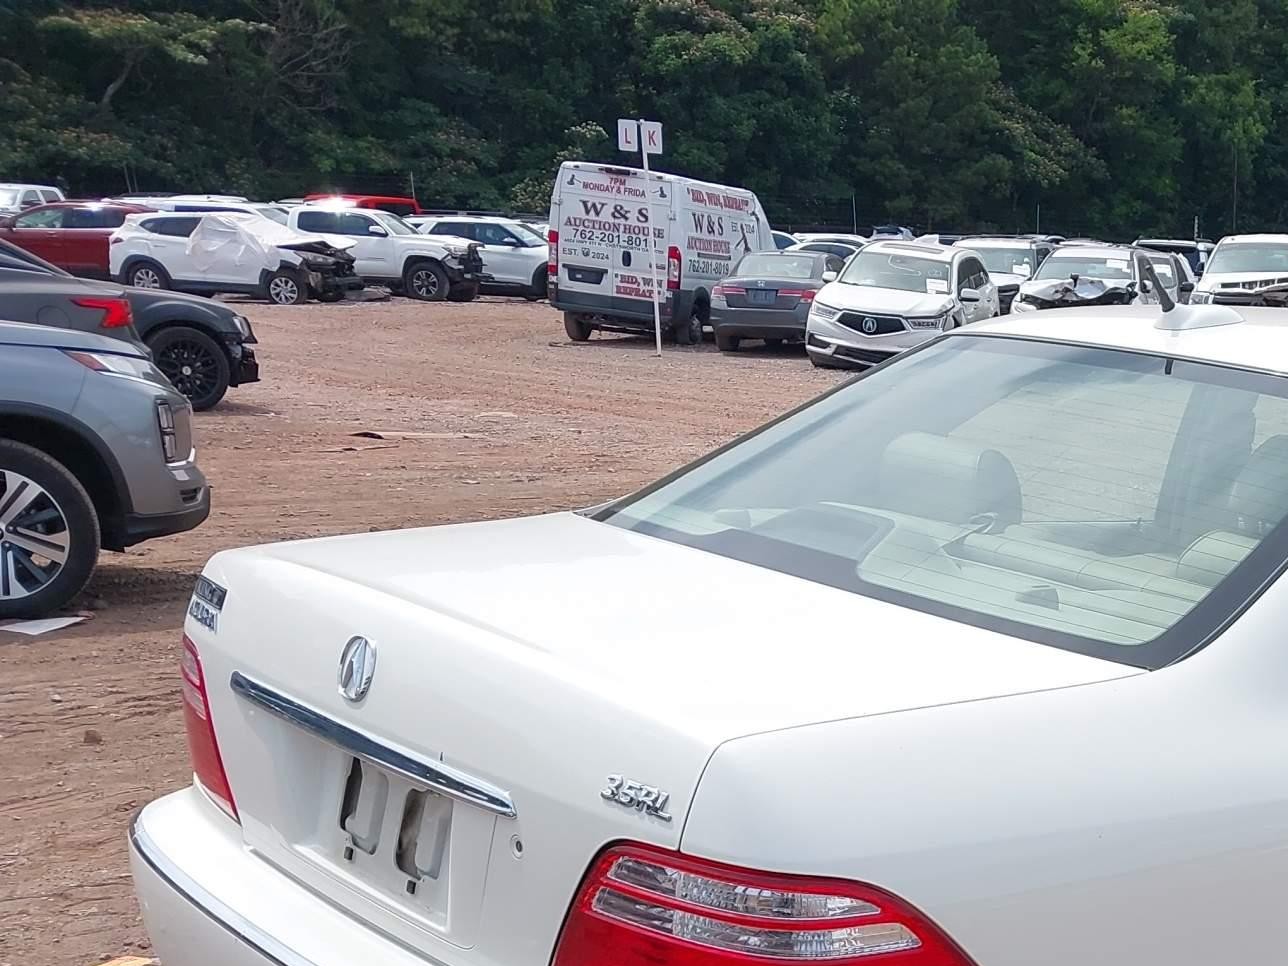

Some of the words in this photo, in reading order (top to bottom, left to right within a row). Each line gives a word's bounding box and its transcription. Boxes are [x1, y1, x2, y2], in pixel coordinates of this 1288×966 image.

[624, 128, 632, 144] L
[648, 130, 656, 146] K
[609, 177, 626, 186] 7PM
[582, 182, 614, 192] MONDAY
[623, 187, 646, 198] FRIDA
[580, 200, 608, 217] W
[611, 204, 631, 221] &
[636, 208, 649, 223] S
[564, 216, 620, 233] AUCTION
[692, 212, 704, 234] W
[707, 215, 715, 237] &
[718, 216, 724, 236] S
[687, 236, 712, 253] AUCTION
[713, 239, 730, 254] HOUSE
[562, 248, 578, 256] EST.
[592, 252, 609, 260] 2024
[688, 260, 729, 275] 762-201-8019
